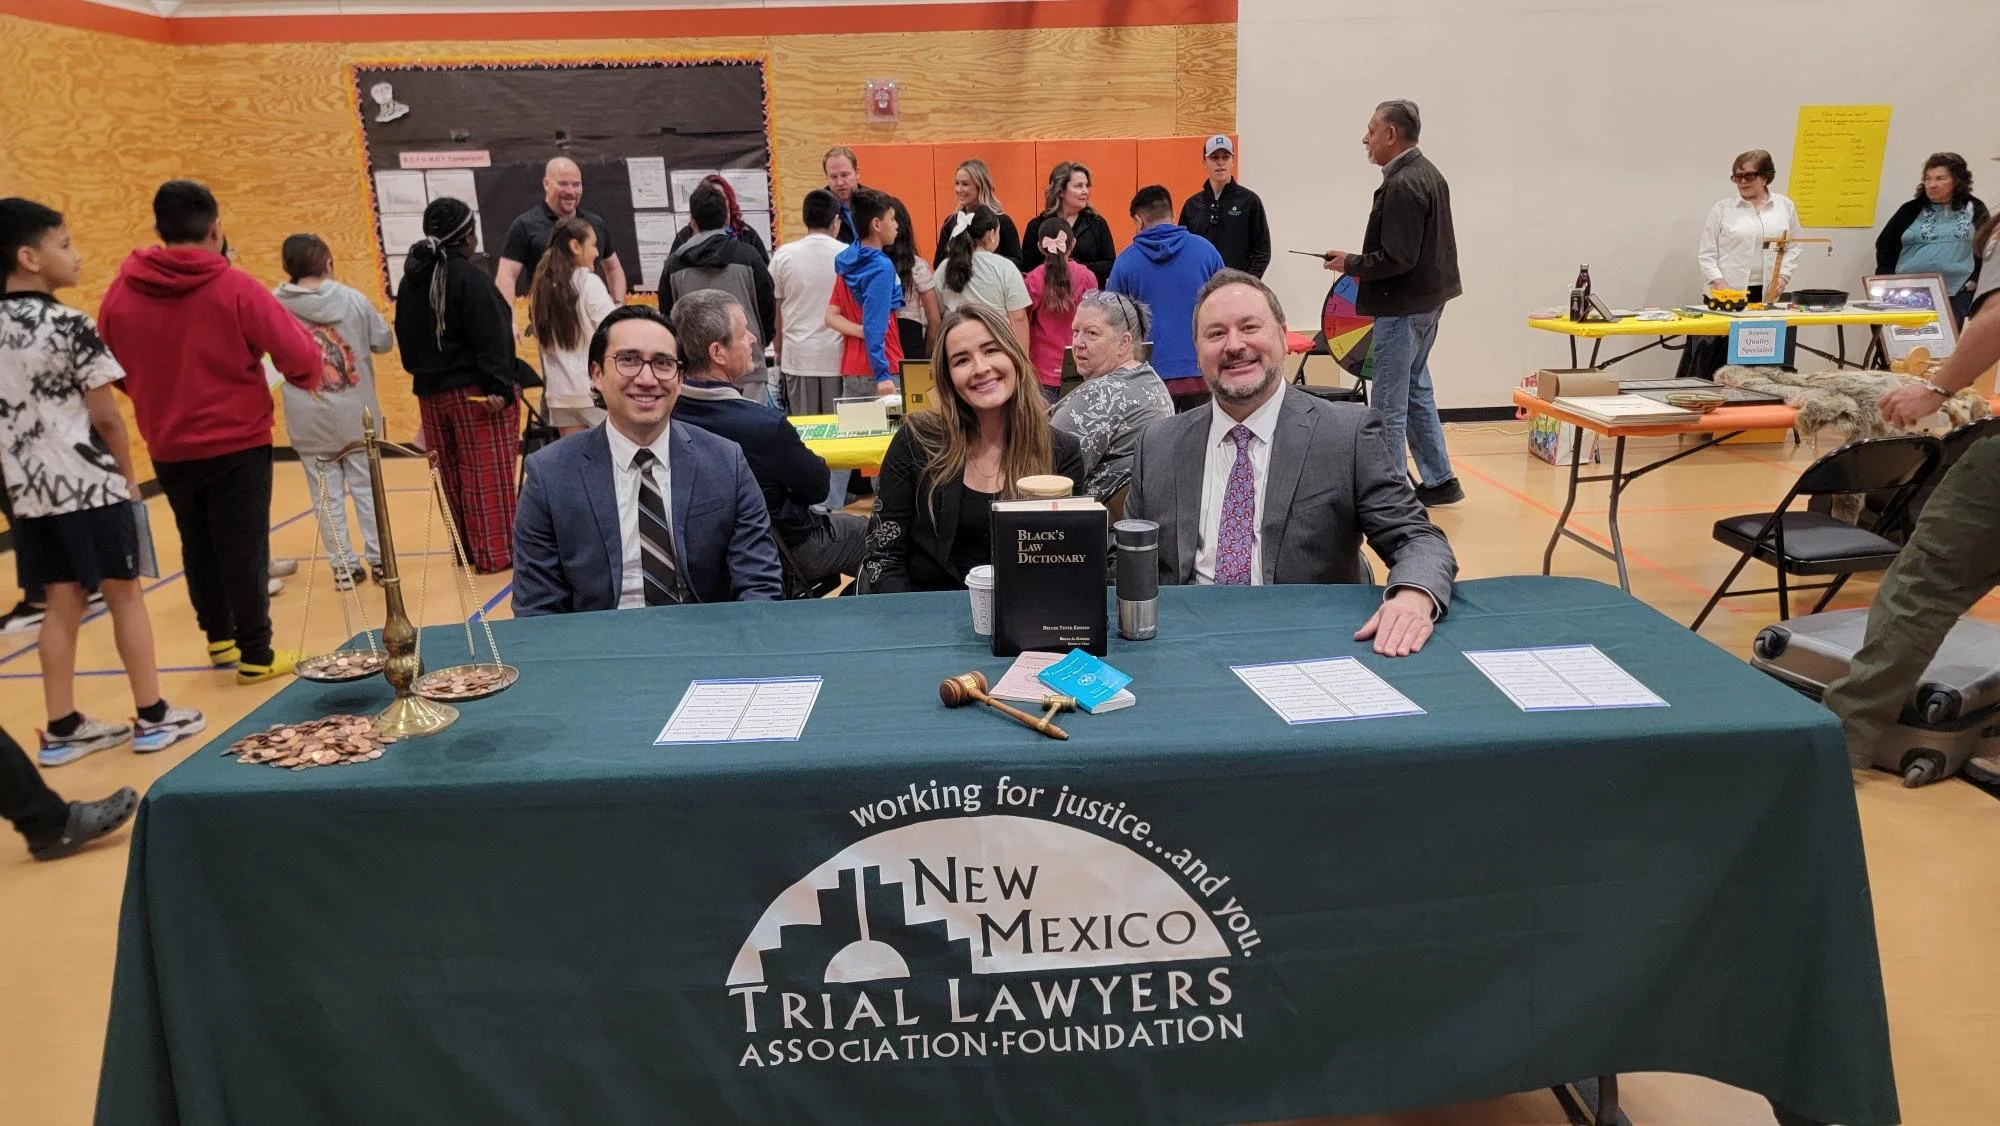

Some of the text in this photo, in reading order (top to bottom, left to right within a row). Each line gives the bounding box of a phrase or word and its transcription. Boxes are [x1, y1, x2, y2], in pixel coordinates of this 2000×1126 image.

[1745, 338, 1769, 346] Quality
[850, 779, 982, 828] working
[997, 776, 1045, 807] for
[1212, 896, 1261, 958] you.
